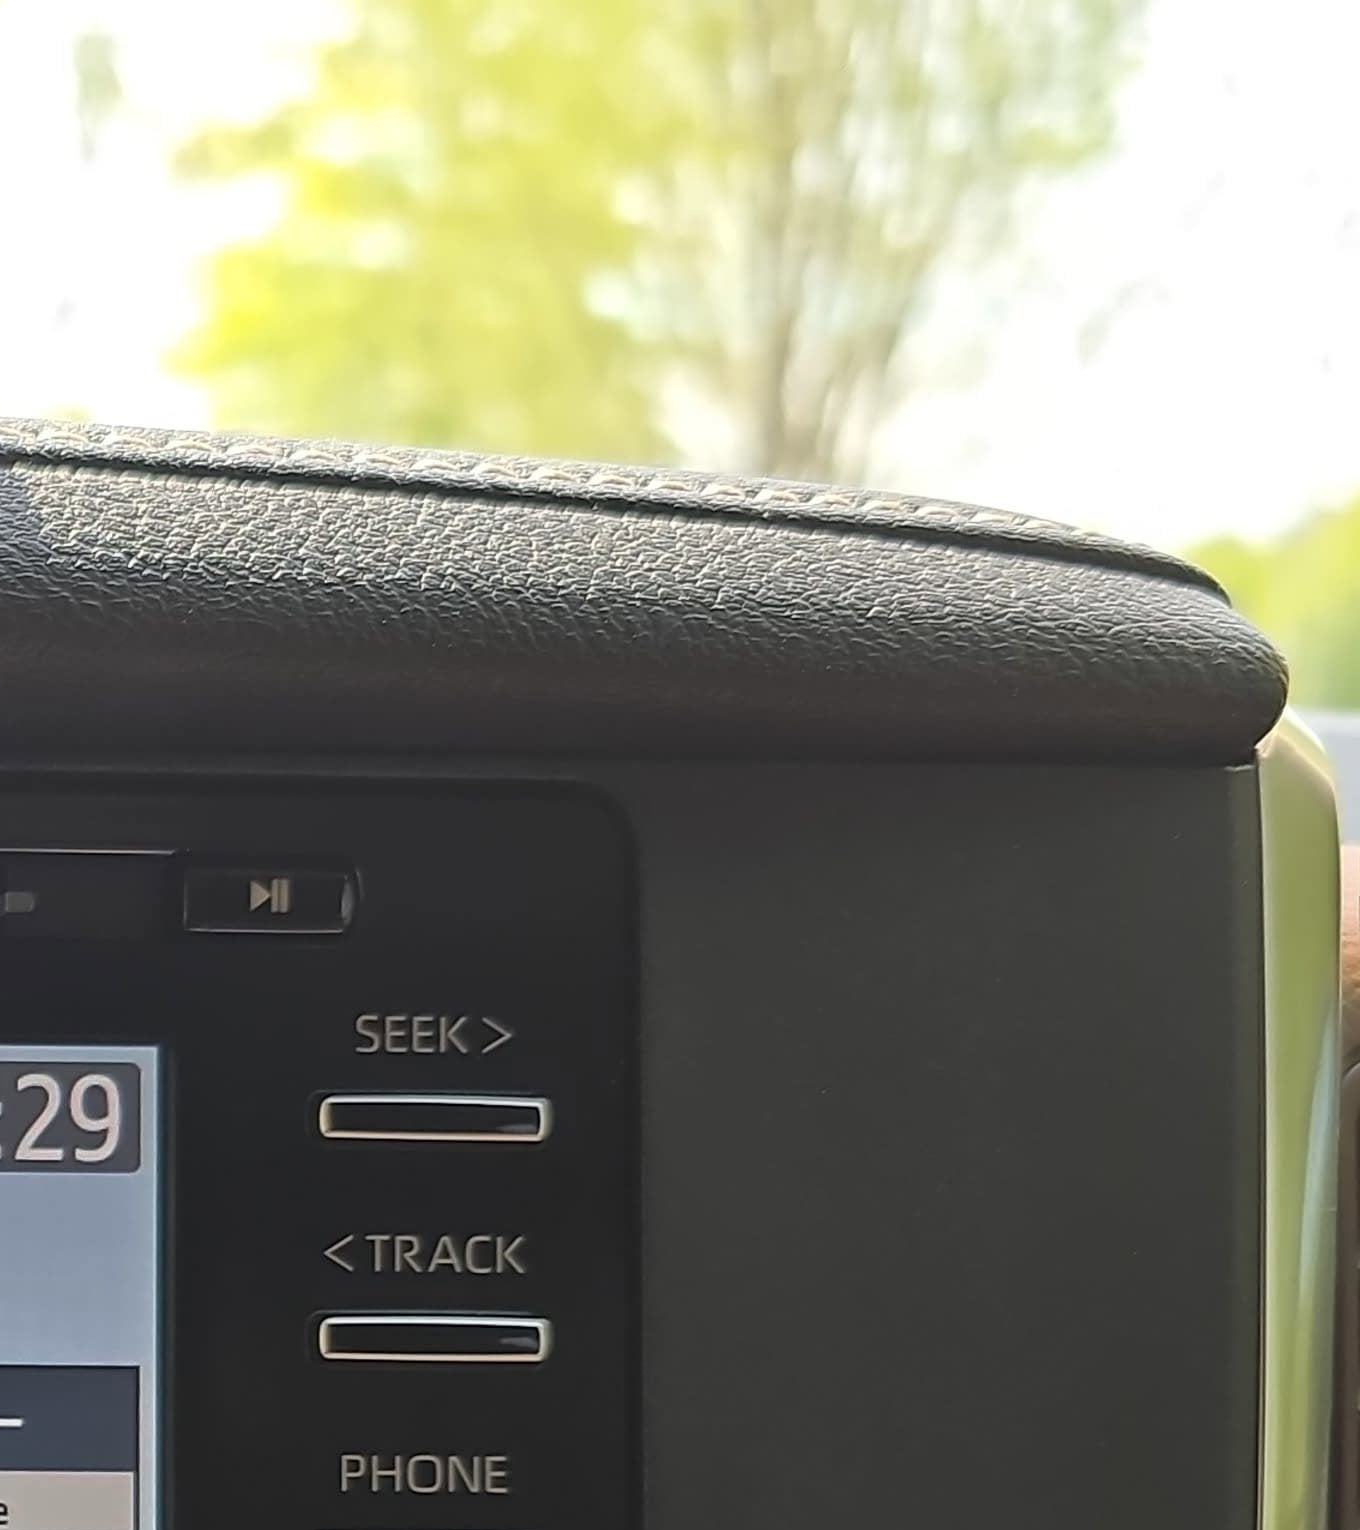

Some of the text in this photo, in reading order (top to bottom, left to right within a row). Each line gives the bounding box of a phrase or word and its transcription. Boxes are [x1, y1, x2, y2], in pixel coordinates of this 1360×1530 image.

[354, 1013, 470, 1055] SEEK
[365, 1233, 526, 1275] TRACK
[339, 1453, 510, 1495] PHONE
